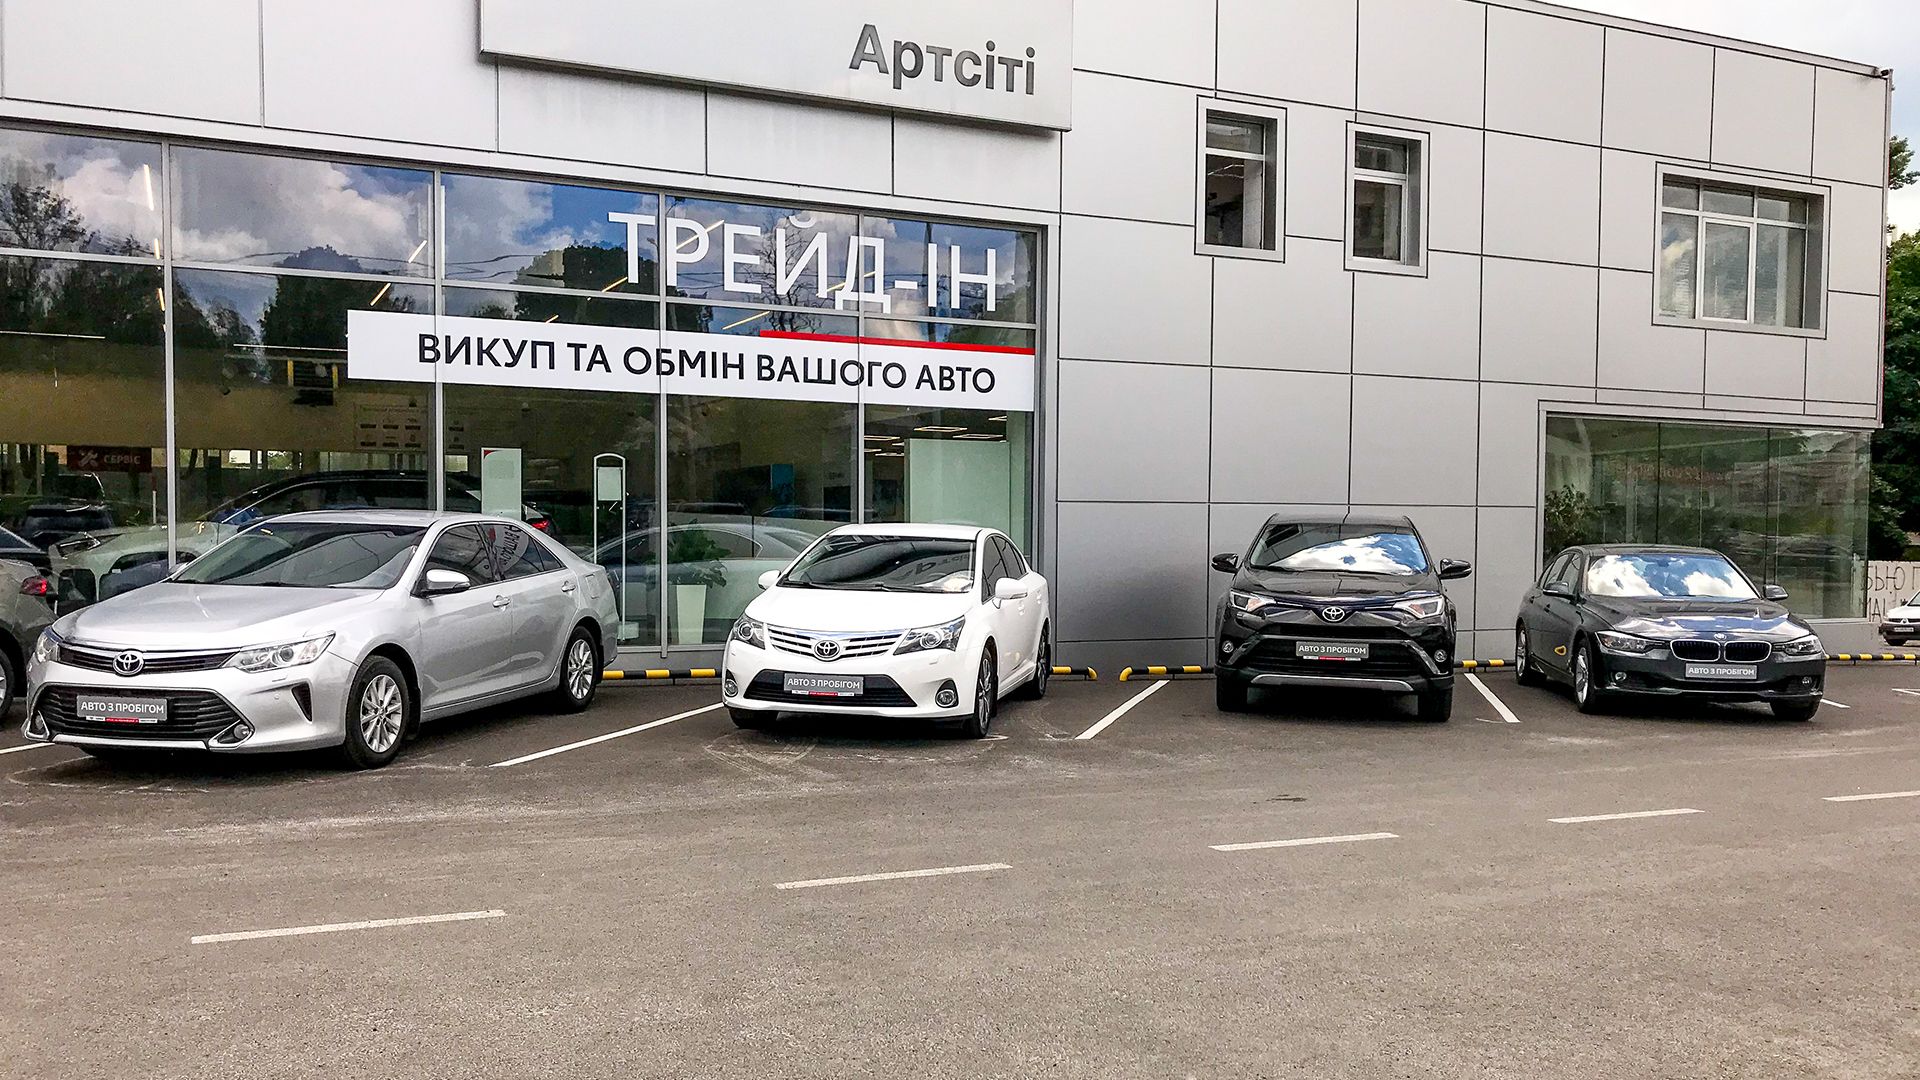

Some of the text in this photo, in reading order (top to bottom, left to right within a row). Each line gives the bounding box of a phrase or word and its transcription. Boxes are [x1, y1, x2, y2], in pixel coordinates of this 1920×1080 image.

[848, 23, 1036, 96] Артсіті
[607, 210, 997, 314] ТРЕЙД-ІН
[418, 333, 996, 394] ВИКУП ТА ОБМІН ВАШОГО АВТО
[1298, 645, 1320, 653] АВТО
[1326, 646, 1366, 654] ПРОБІГОМ
[1688, 667, 1710, 675] АВТО
[1716, 668, 1755, 676] ПРОБІГОМ
[787, 678, 810, 687] АВТО
[817, 679, 860, 689] ПРОБІГОМ
[80, 701, 106, 712] АВТО
[115, 703, 164, 714] ПРОБІГОМ
